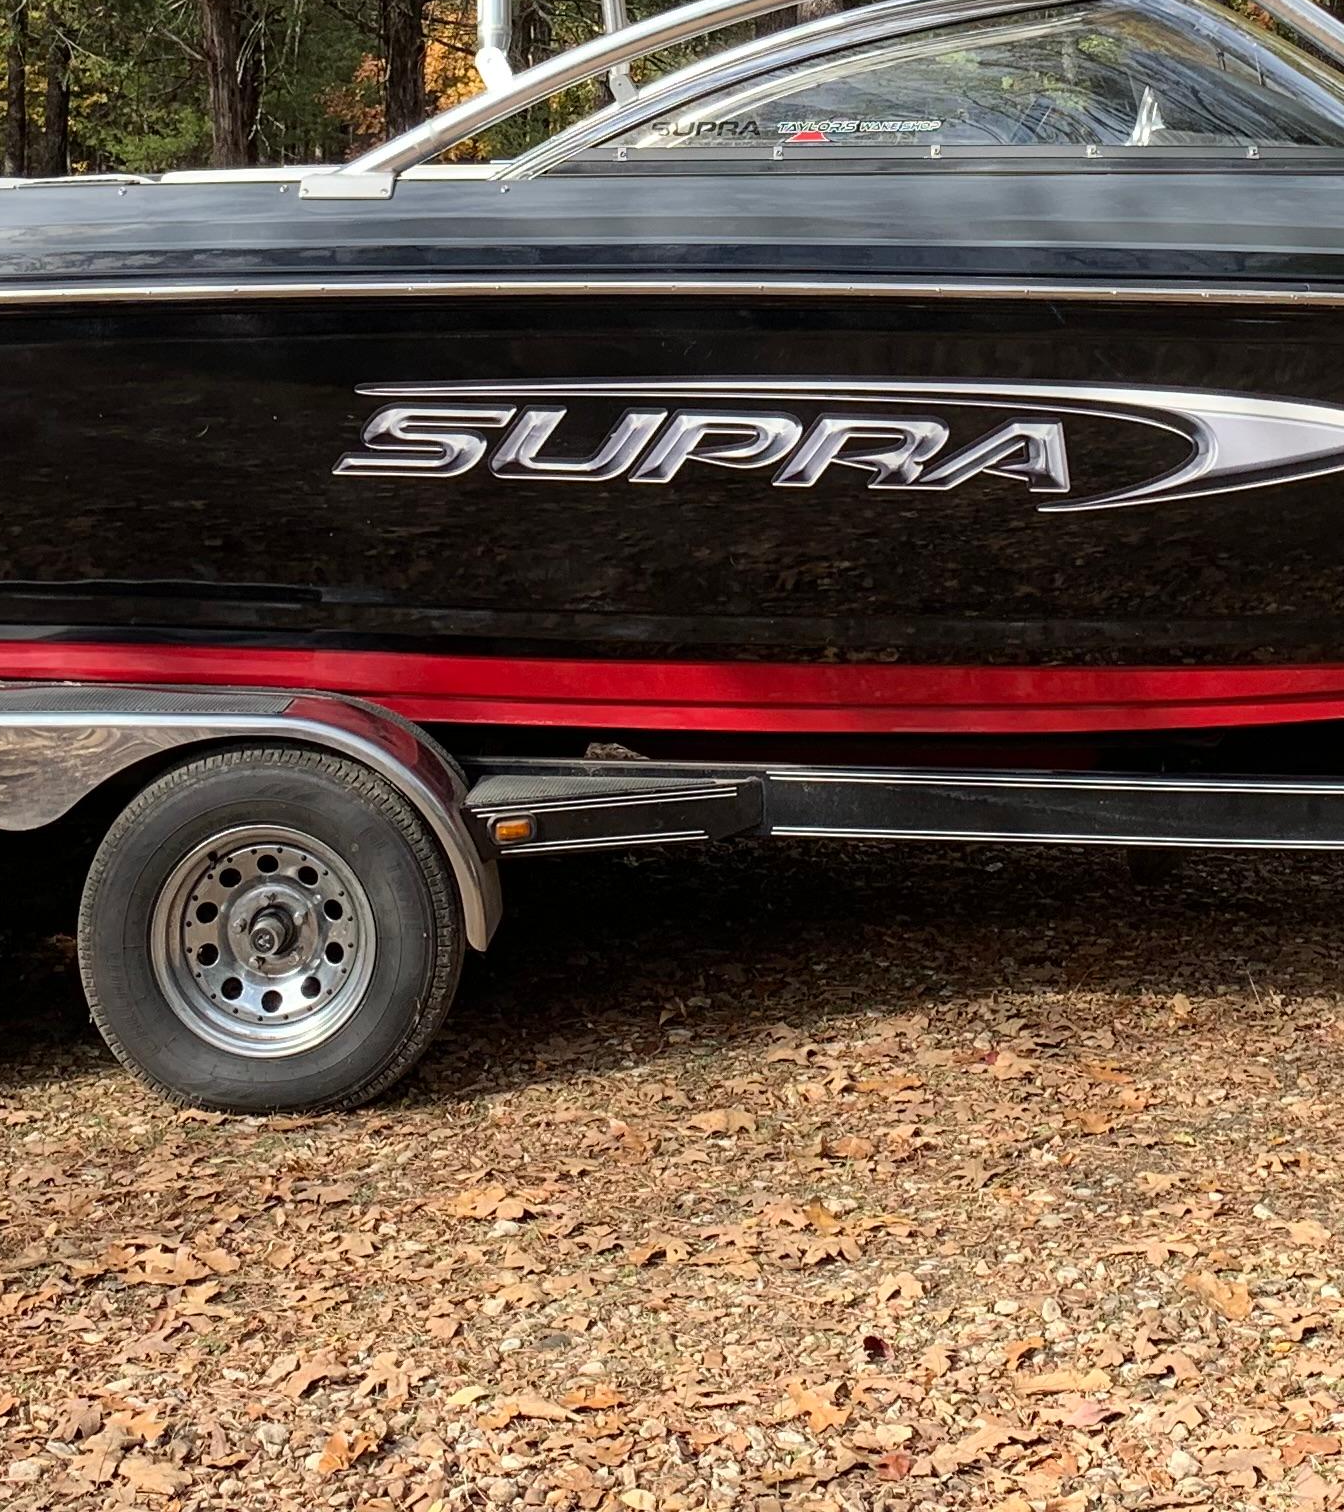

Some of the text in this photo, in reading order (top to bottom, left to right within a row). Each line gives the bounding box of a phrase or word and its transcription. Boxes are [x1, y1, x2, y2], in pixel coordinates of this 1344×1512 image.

[652, 120, 760, 137] SUPRA
[859, 120, 901, 132] WAKE
[901, 119, 943, 132] SHOP
[331, 402, 1071, 493] SUPRA
